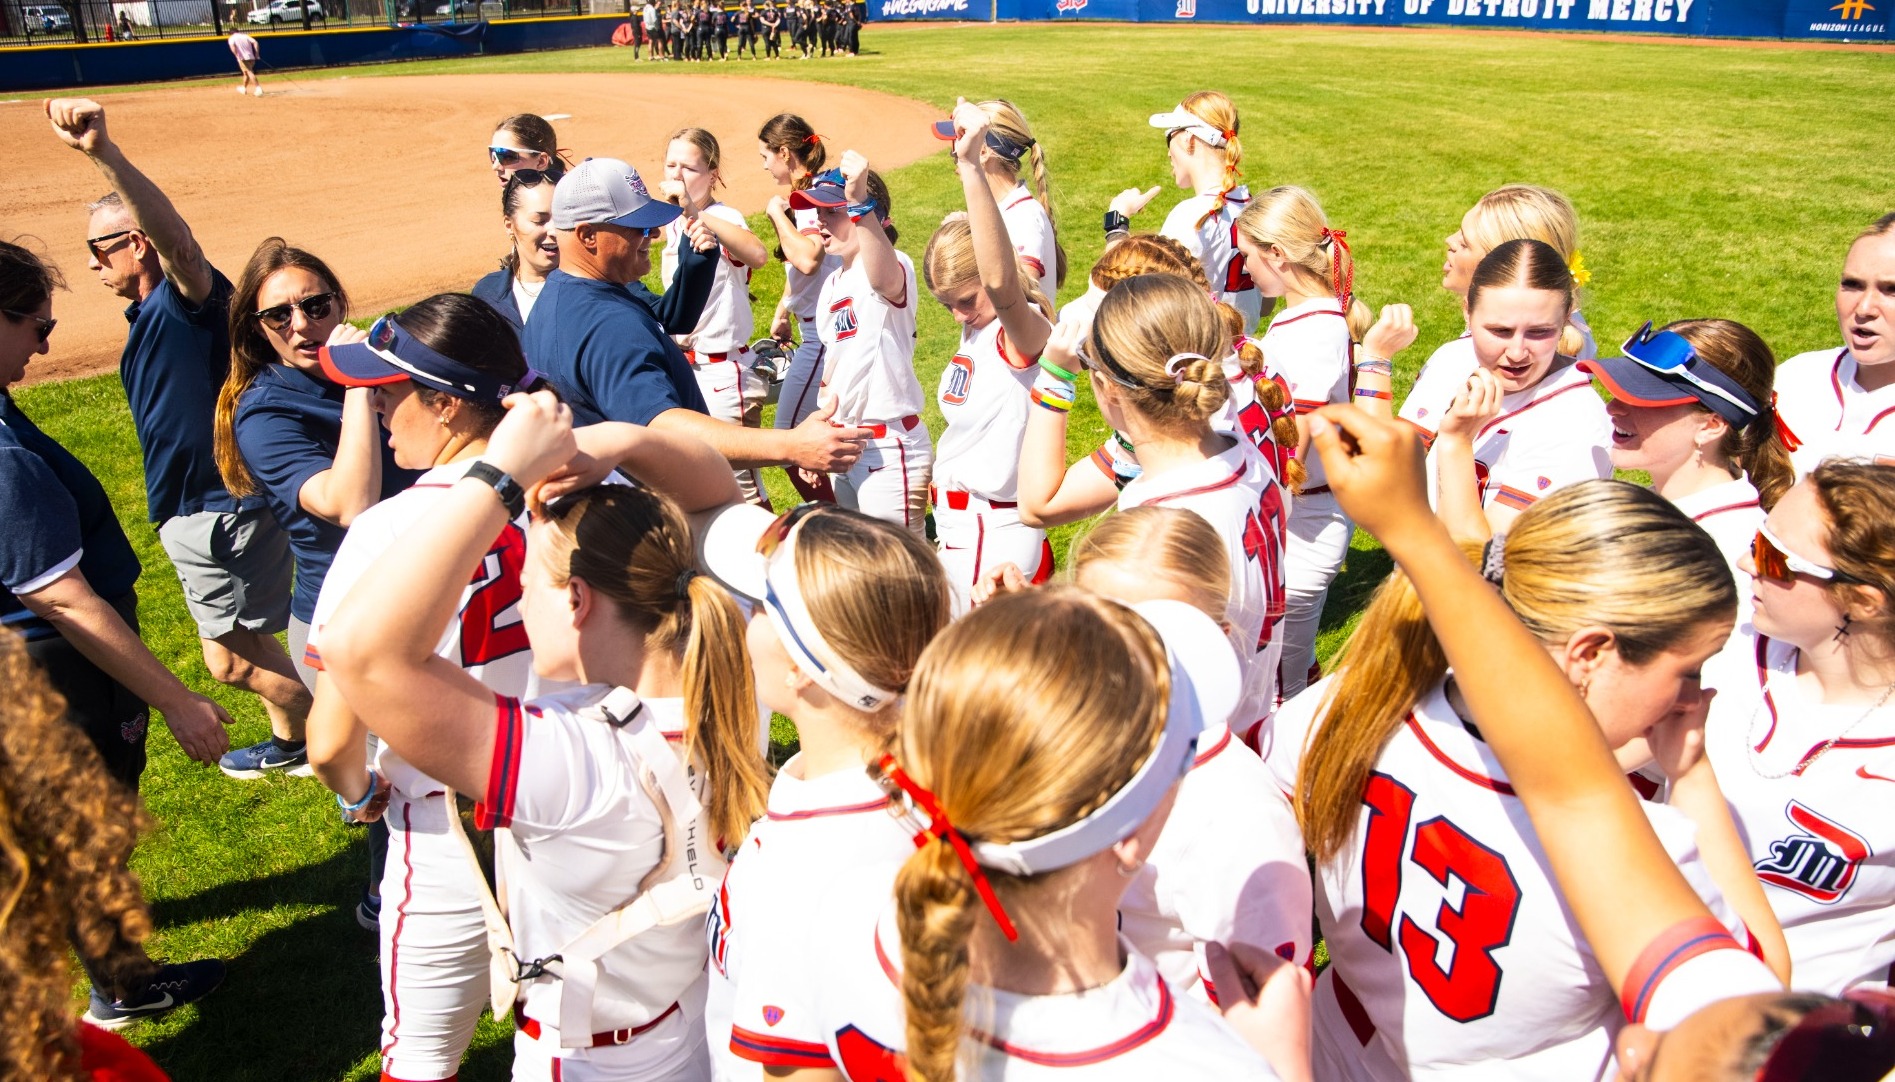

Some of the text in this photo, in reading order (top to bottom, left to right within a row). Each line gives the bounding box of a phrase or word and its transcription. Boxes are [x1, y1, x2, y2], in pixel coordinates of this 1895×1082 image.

[1246, 0, 1695, 22] UNIVERSITY OF DETROIT MERCY
[1809, 23, 1848, 32] HORIZON
[1360, 771, 1522, 1023] 13
